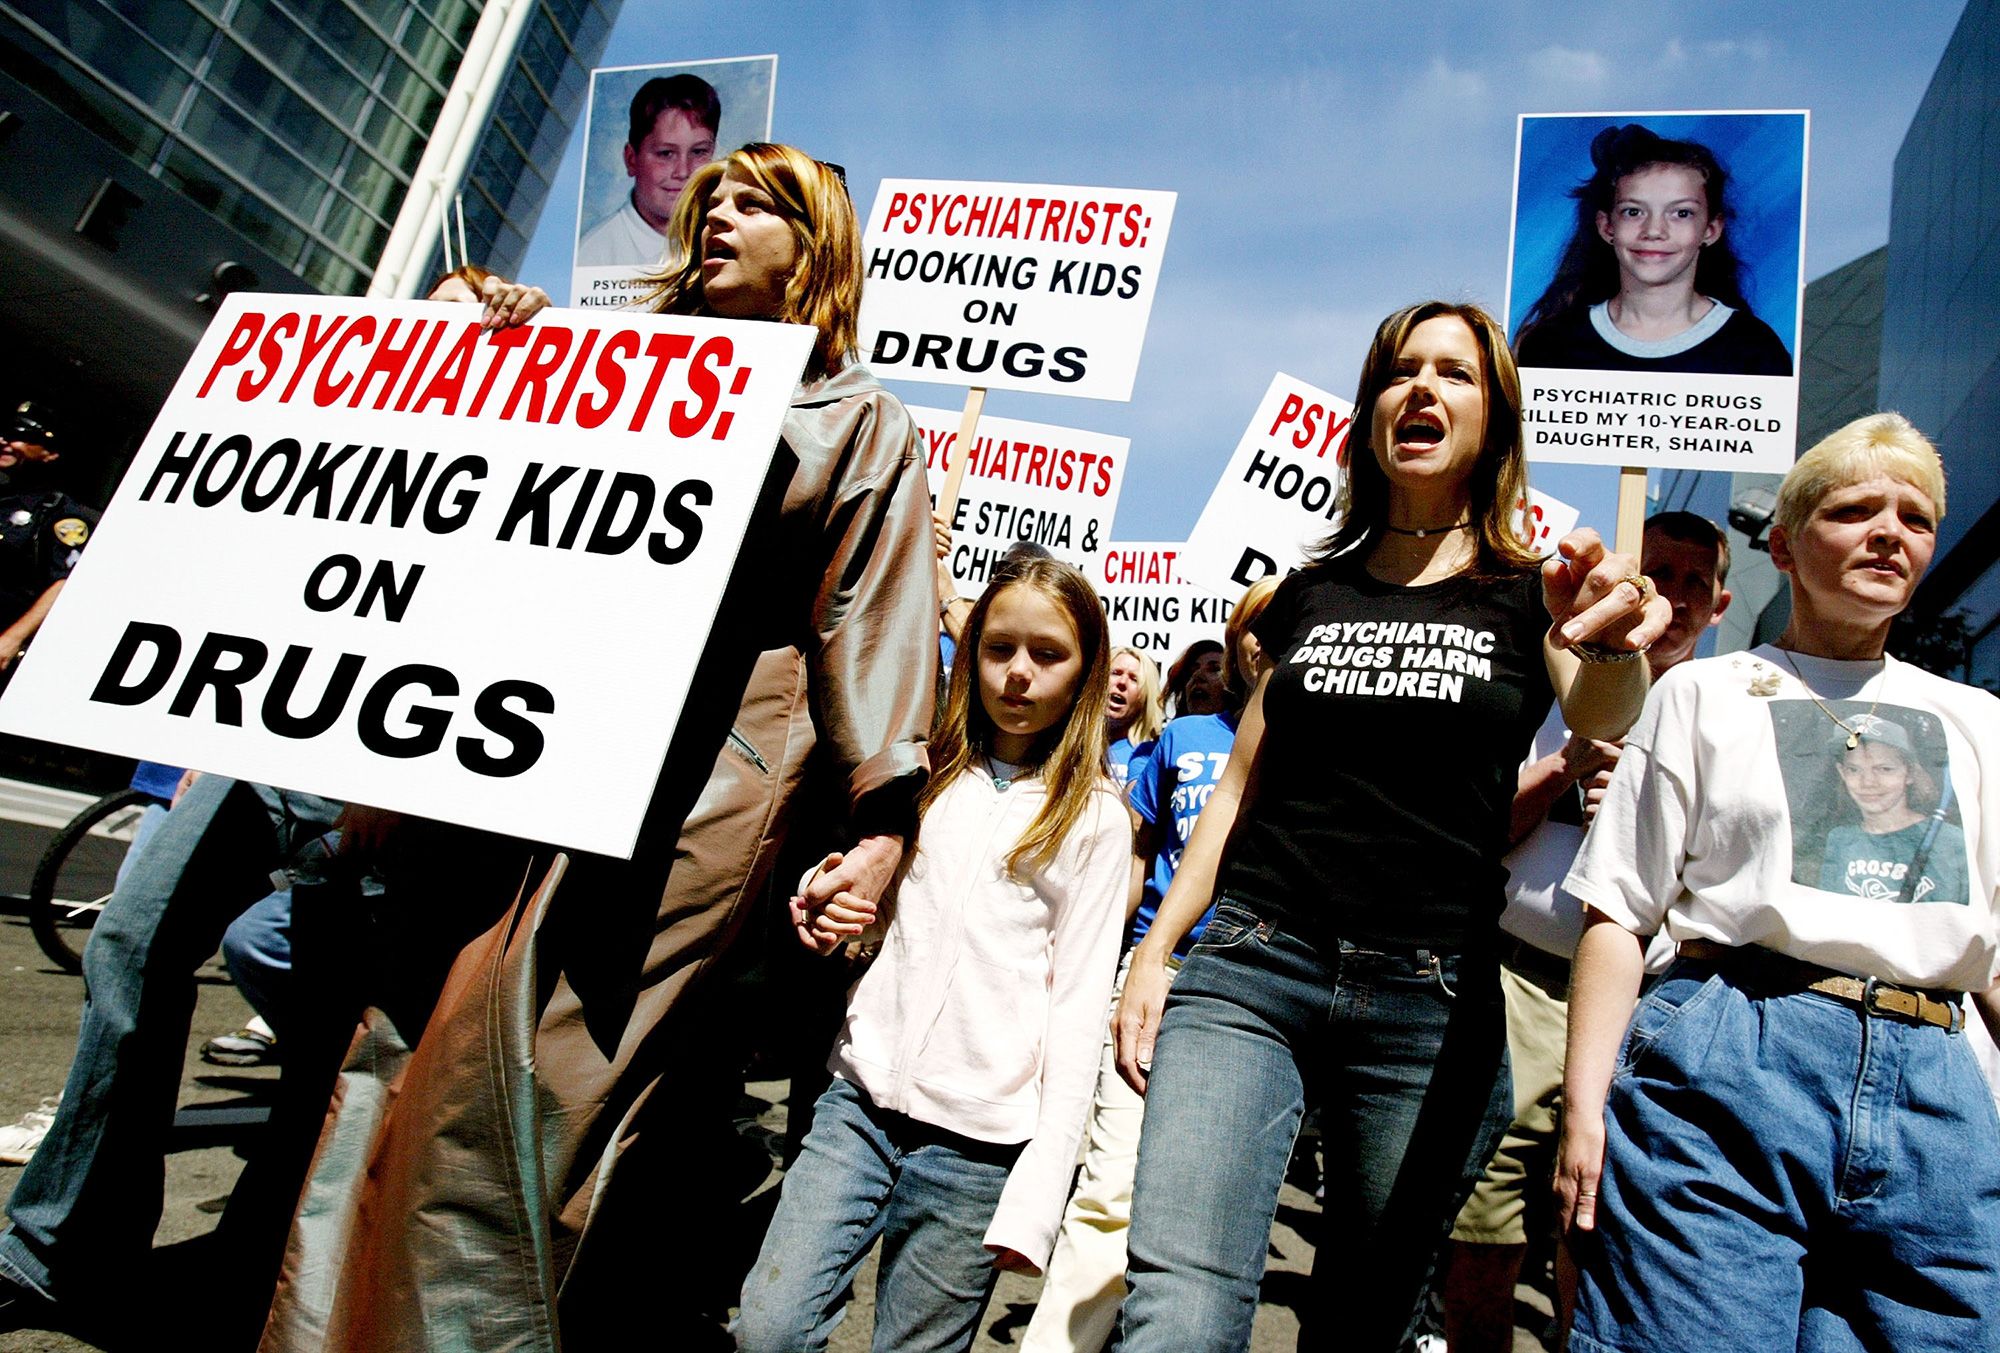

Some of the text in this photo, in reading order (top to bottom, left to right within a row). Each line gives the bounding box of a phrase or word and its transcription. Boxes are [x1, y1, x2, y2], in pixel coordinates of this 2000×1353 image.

[882, 192, 1152, 248] PSYCHIATRISTS:
[867, 247, 1142, 300] HOOKING KIDS
[963, 299, 1018, 326] ON
[870, 330, 1088, 384] DRUGS
[196, 311, 753, 441] PSYCHIATRISTS:
[1532, 388, 1763, 411] PSYCHIATRIC DRUGS
[1596, 411, 1628, 427] MY
[1637, 413, 1781, 433] 10-YEAR-OLD
[1535, 431, 1754, 454] DAUGHTER, SHAINA
[139, 431, 714, 566] HOOKING KIDS
[975, 501, 1072, 549] STIGMA
[1081, 518, 1099, 553] &
[302, 554, 426, 624] ON
[1131, 631, 1170, 650] ON
[1304, 621, 1496, 654] PSYCHIATRIC
[1289, 645, 1492, 682] DRUGS HARM
[89, 620, 555, 778] DRUGS
[1303, 666, 1465, 703] CHILDREN
[1176, 751, 1231, 783] ST
[1847, 859, 1909, 881] CROSB
